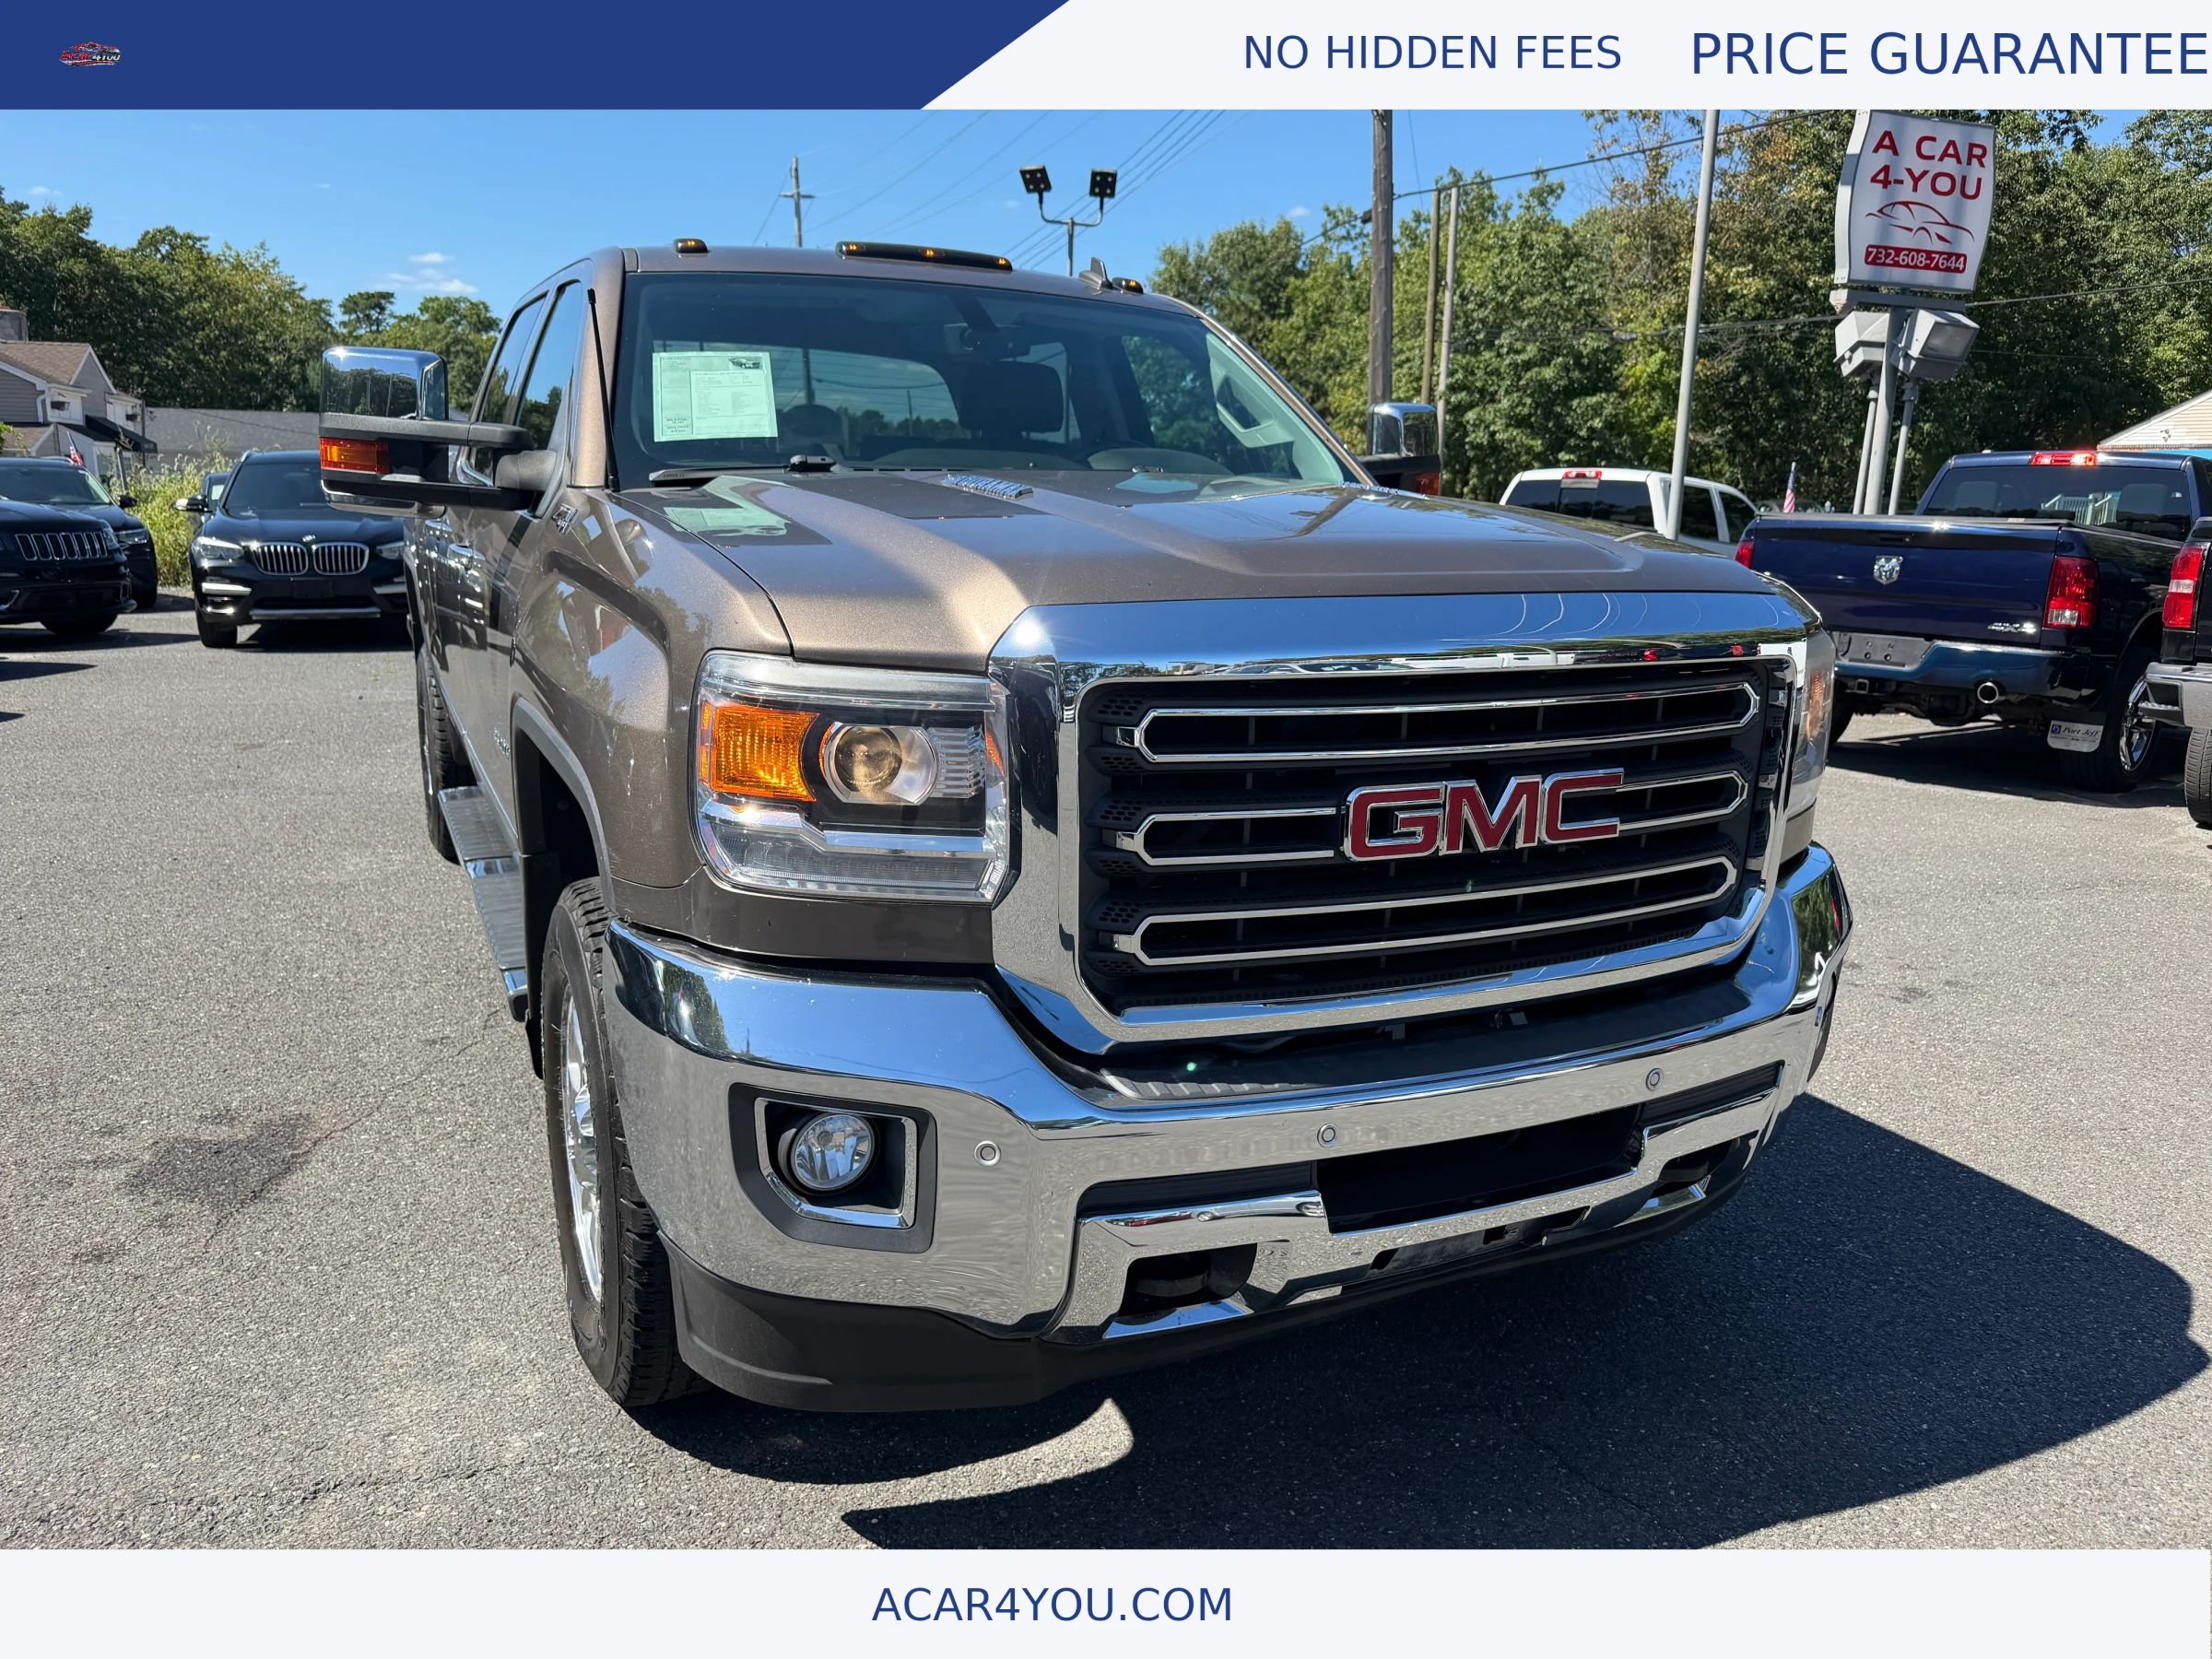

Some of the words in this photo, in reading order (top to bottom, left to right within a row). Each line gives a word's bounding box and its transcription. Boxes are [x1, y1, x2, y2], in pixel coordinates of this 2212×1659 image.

[1872, 130, 1900, 157] A
[1915, 135, 1988, 169] CAR
[1870, 164, 1983, 201] 4-YOU
[1867, 247, 1965, 271] 732-608-7644
[1342, 768, 1624, 862] GMC
